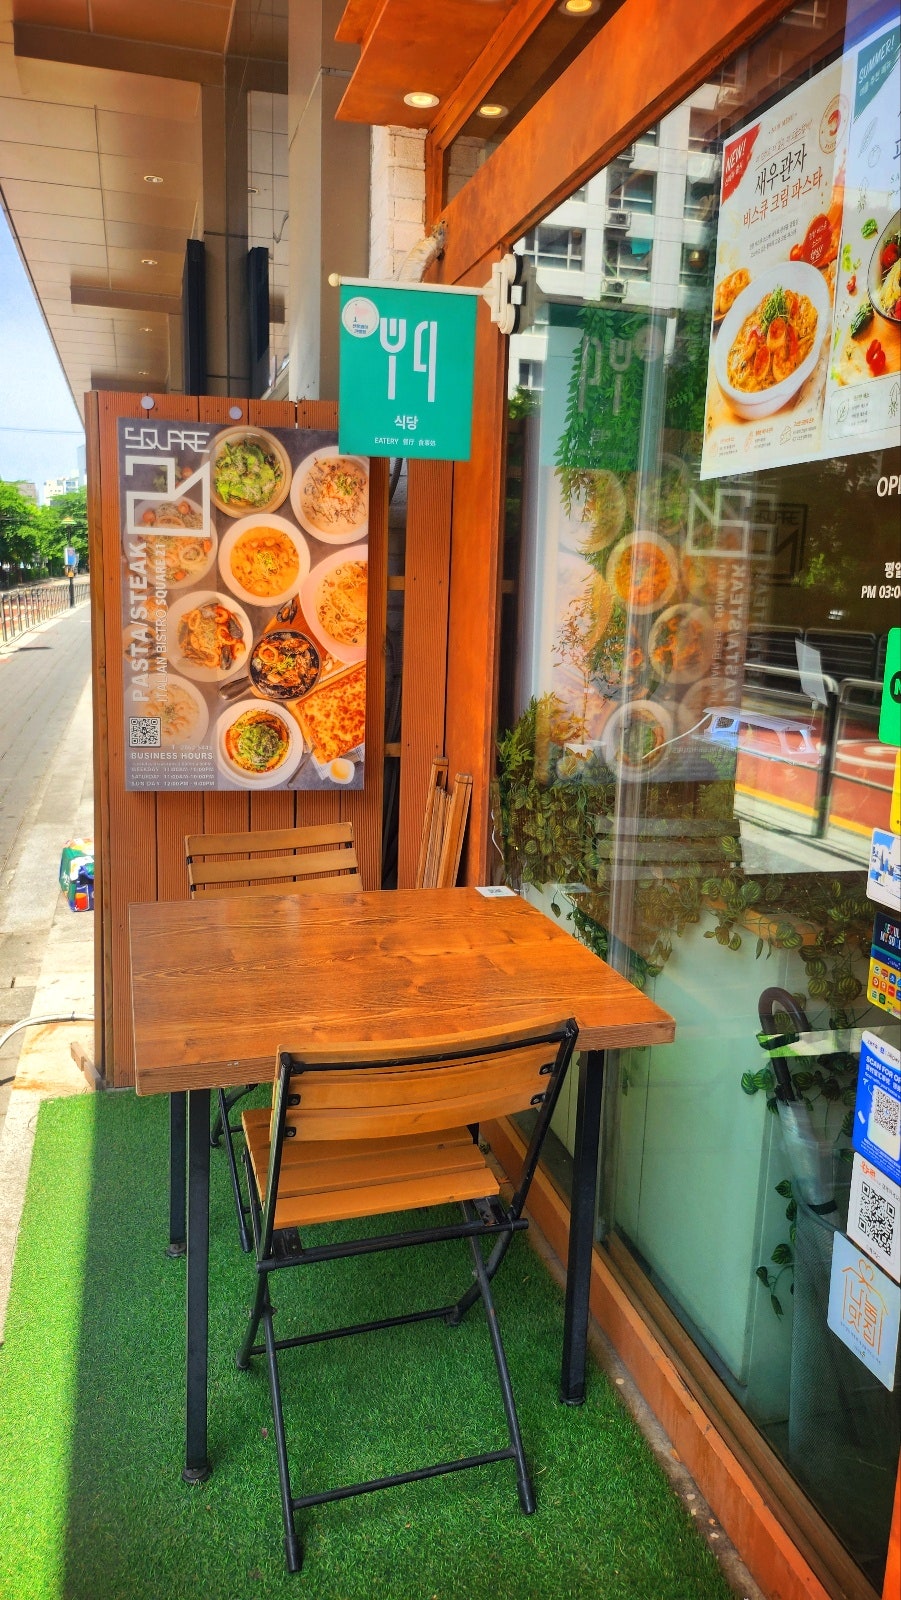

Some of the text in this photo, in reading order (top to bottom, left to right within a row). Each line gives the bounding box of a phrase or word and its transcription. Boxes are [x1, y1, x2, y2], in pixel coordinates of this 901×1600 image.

[754, 143, 807, 197] 새우관자
[743, 166, 823, 229] 비스큐 크림 파스타
[394, 415, 419, 430] 식당
[374, 437, 399, 445] EATERY
[876, 475, 901, 497] OP
[861, 585, 876, 599] PM
[129, 542, 149, 703] PASTA/STEAK
[155, 543, 168, 702] ITALIAN BISTRO SQUARE 21
[131, 752, 213, 760] BUSINESS HOURS
[866, 1055, 882, 1071] SCAN
[882, 1065, 893, 1079] FOR
